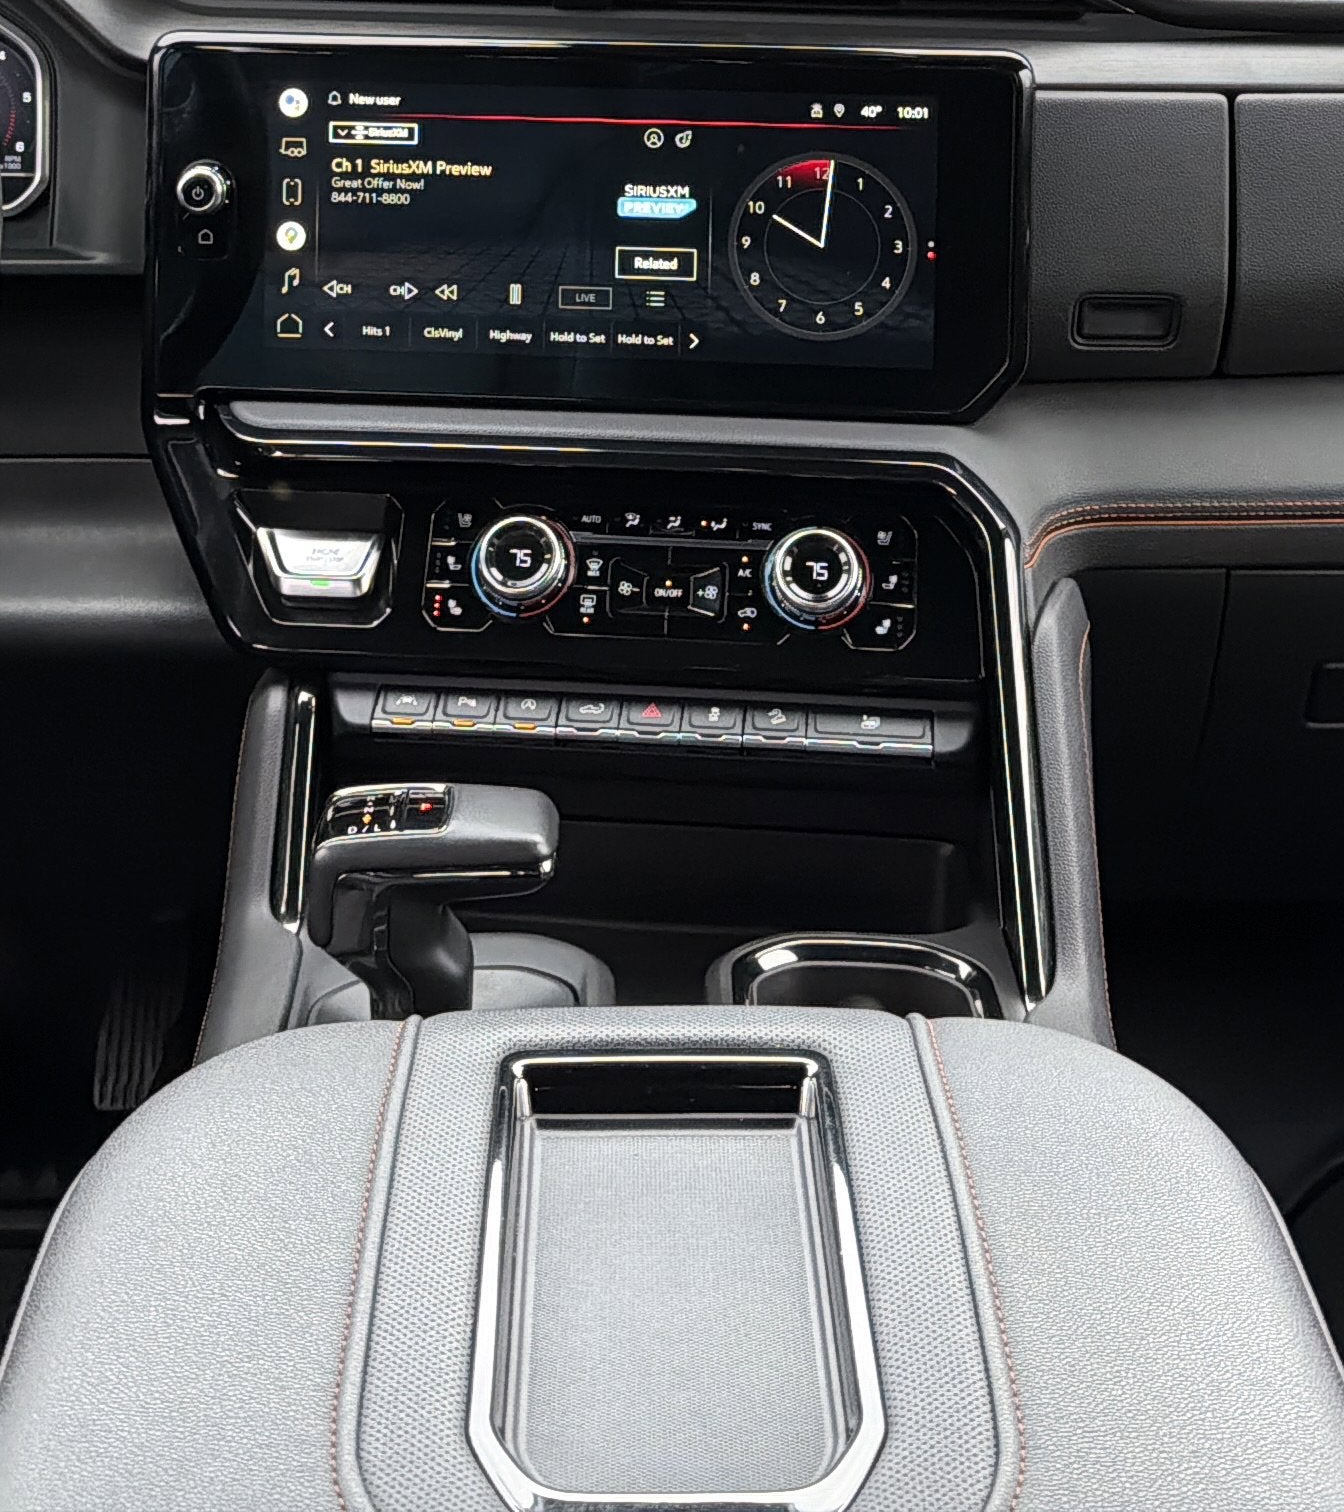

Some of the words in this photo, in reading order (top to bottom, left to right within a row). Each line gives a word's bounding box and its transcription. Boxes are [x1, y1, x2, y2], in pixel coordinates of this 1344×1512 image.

[349, 93, 375, 105] New
[376, 95, 402, 106] user
[896, 106, 929, 119] 10:01
[331, 158, 352, 173] Ch
[355, 159, 363, 173] 1
[370, 159, 433, 175] SiriusXM
[436, 161, 493, 176] Preview
[331, 176, 362, 189] Great
[364, 177, 394, 189] Offer
[396, 179, 425, 190] Now!
[776, 176, 792, 188] 11
[857, 178, 863, 190] 1
[624, 183, 690, 198] SIRIUSXM
[331, 192, 410, 205] 844-711-8800
[748, 200, 765, 214] 10
[884, 205, 893, 219] 2
[741, 236, 751, 249] 9
[893, 240, 903, 254] 3
[634, 256, 678, 270] Related
[750, 272, 760, 286] 8
[881, 276, 891, 290] 4
[337, 284, 352, 294] CH
[389, 285, 405, 296] CH
[576, 293, 596, 303] LIVE
[777, 299, 787, 313] 7
[854, 302, 864, 316] 5
[816, 311, 826, 324] 6
[362, 326, 383, 336] Hits
[489, 329, 532, 344] Highway
[550, 331, 574, 342] Hold
[575, 332, 588, 342] to
[589, 332, 606, 344] Set
[617, 333, 642, 345] Hold
[643, 335, 656, 345] to
[656, 335, 674, 346] Set
[581, 514, 602, 524] AUTO
[752, 521, 773, 532] SYNC
[509, 548, 532, 568] 75
[737, 569, 753, 578] A/C
[806, 561, 829, 581] 75
[654, 588, 684, 598] ON/OFF
